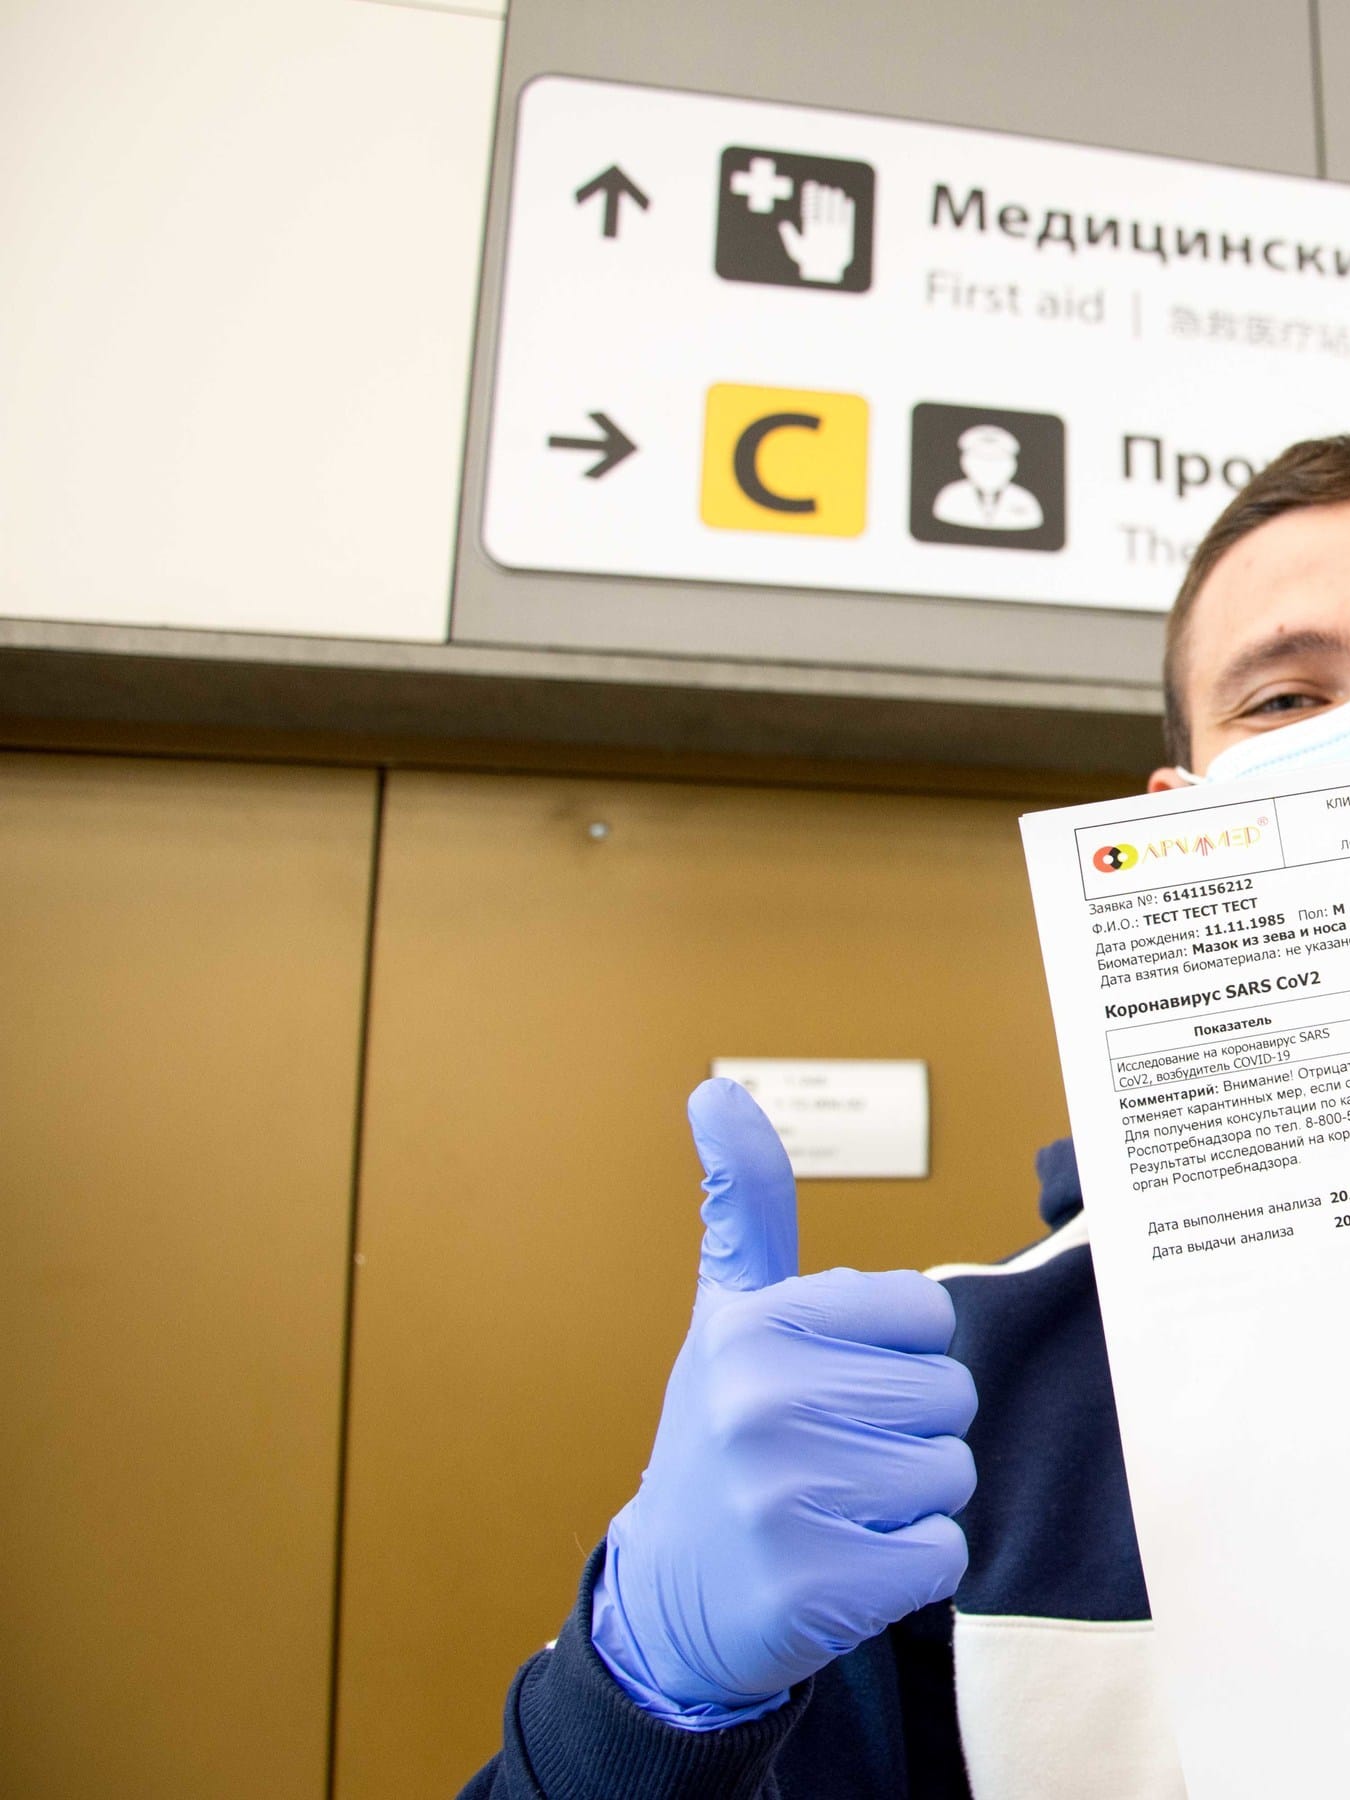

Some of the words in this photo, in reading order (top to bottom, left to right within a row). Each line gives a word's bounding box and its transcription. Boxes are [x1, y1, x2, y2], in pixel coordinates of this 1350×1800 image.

[926, 271, 1020, 317] First
[1036, 284, 1105, 325] aid
[1123, 435, 1268, 498] Про
[1089, 900, 1133, 916] Заявка
[1162, 878, 1254, 903] 6141156212
[1092, 918, 1139, 935] Ф.И.О.:
[1142, 909, 1179, 926] ТЕСТ
[1182, 903, 1219, 920] ТЕСТ
[1221, 897, 1258, 913] ТЕСТ
[1095, 941, 1127, 957] Дата
[1130, 929, 1200, 952] рождения:
[1204, 913, 1286, 937] 11.11.1985
[1298, 908, 1328, 921] Пол:
[1097, 948, 1188, 971] Биоматериал:
[1191, 939, 1239, 956] Мазок
[1242, 936, 1260, 947] из
[1262, 930, 1296, 944] зева
[1299, 927, 1309, 938] и
[1312, 921, 1347, 936] носа
[1100, 973, 1132, 990] Дата
[1135, 965, 1179, 981] взятия
[1182, 948, 1281, 974] биоматериала:
[1285, 945, 1302, 956] не
[1104, 989, 1222, 1019] Коронавирус
[1225, 978, 1272, 999] SARS
[1276, 970, 1321, 991] CoV2
[1193, 1016, 1272, 1037] Показатель
[1116, 1051, 1200, 1073] Исследование
[1203, 1048, 1218, 1059] на
[1221, 1035, 1297, 1056] коронавирус
[1299, 1027, 1331, 1043] SARS
[1119, 1073, 1153, 1088] CoV2,
[1156, 1063, 1231, 1082] возбудитель
[1233, 1049, 1291, 1069] COVID-19
[1119, 1083, 1219, 1110] Комментарий:
[1222, 1069, 1294, 1092] Внимание!
[1121, 1107, 1184, 1126] отменяет
[1187, 1092, 1273, 1116] карантинных
[1309, 1080, 1342, 1095] если
[1124, 1129, 1150, 1145] Для
[1153, 1117, 1223, 1137] получения
[1226, 1101, 1317, 1125] консультации
[1320, 1098, 1337, 1110] по
[1126, 1129, 1252, 1159] Роспотребнадзора
[1255, 1126, 1272, 1137] по
[1274, 1121, 1302, 1134] тел.
[1129, 1154, 1207, 1175] Результаты
[1210, 1135, 1305, 1162] исследований
[1308, 1134, 1325, 1145] на
[1132, 1177, 1169, 1193] орган
[1148, 1220, 1179, 1237] Дата
[1183, 1206, 1264, 1229] выполнения
[1268, 1197, 1322, 1215] анализа
[1152, 1245, 1183, 1261] Дата
[1187, 1236, 1236, 1253] выдачи
[1240, 1226, 1294, 1244] анализа
